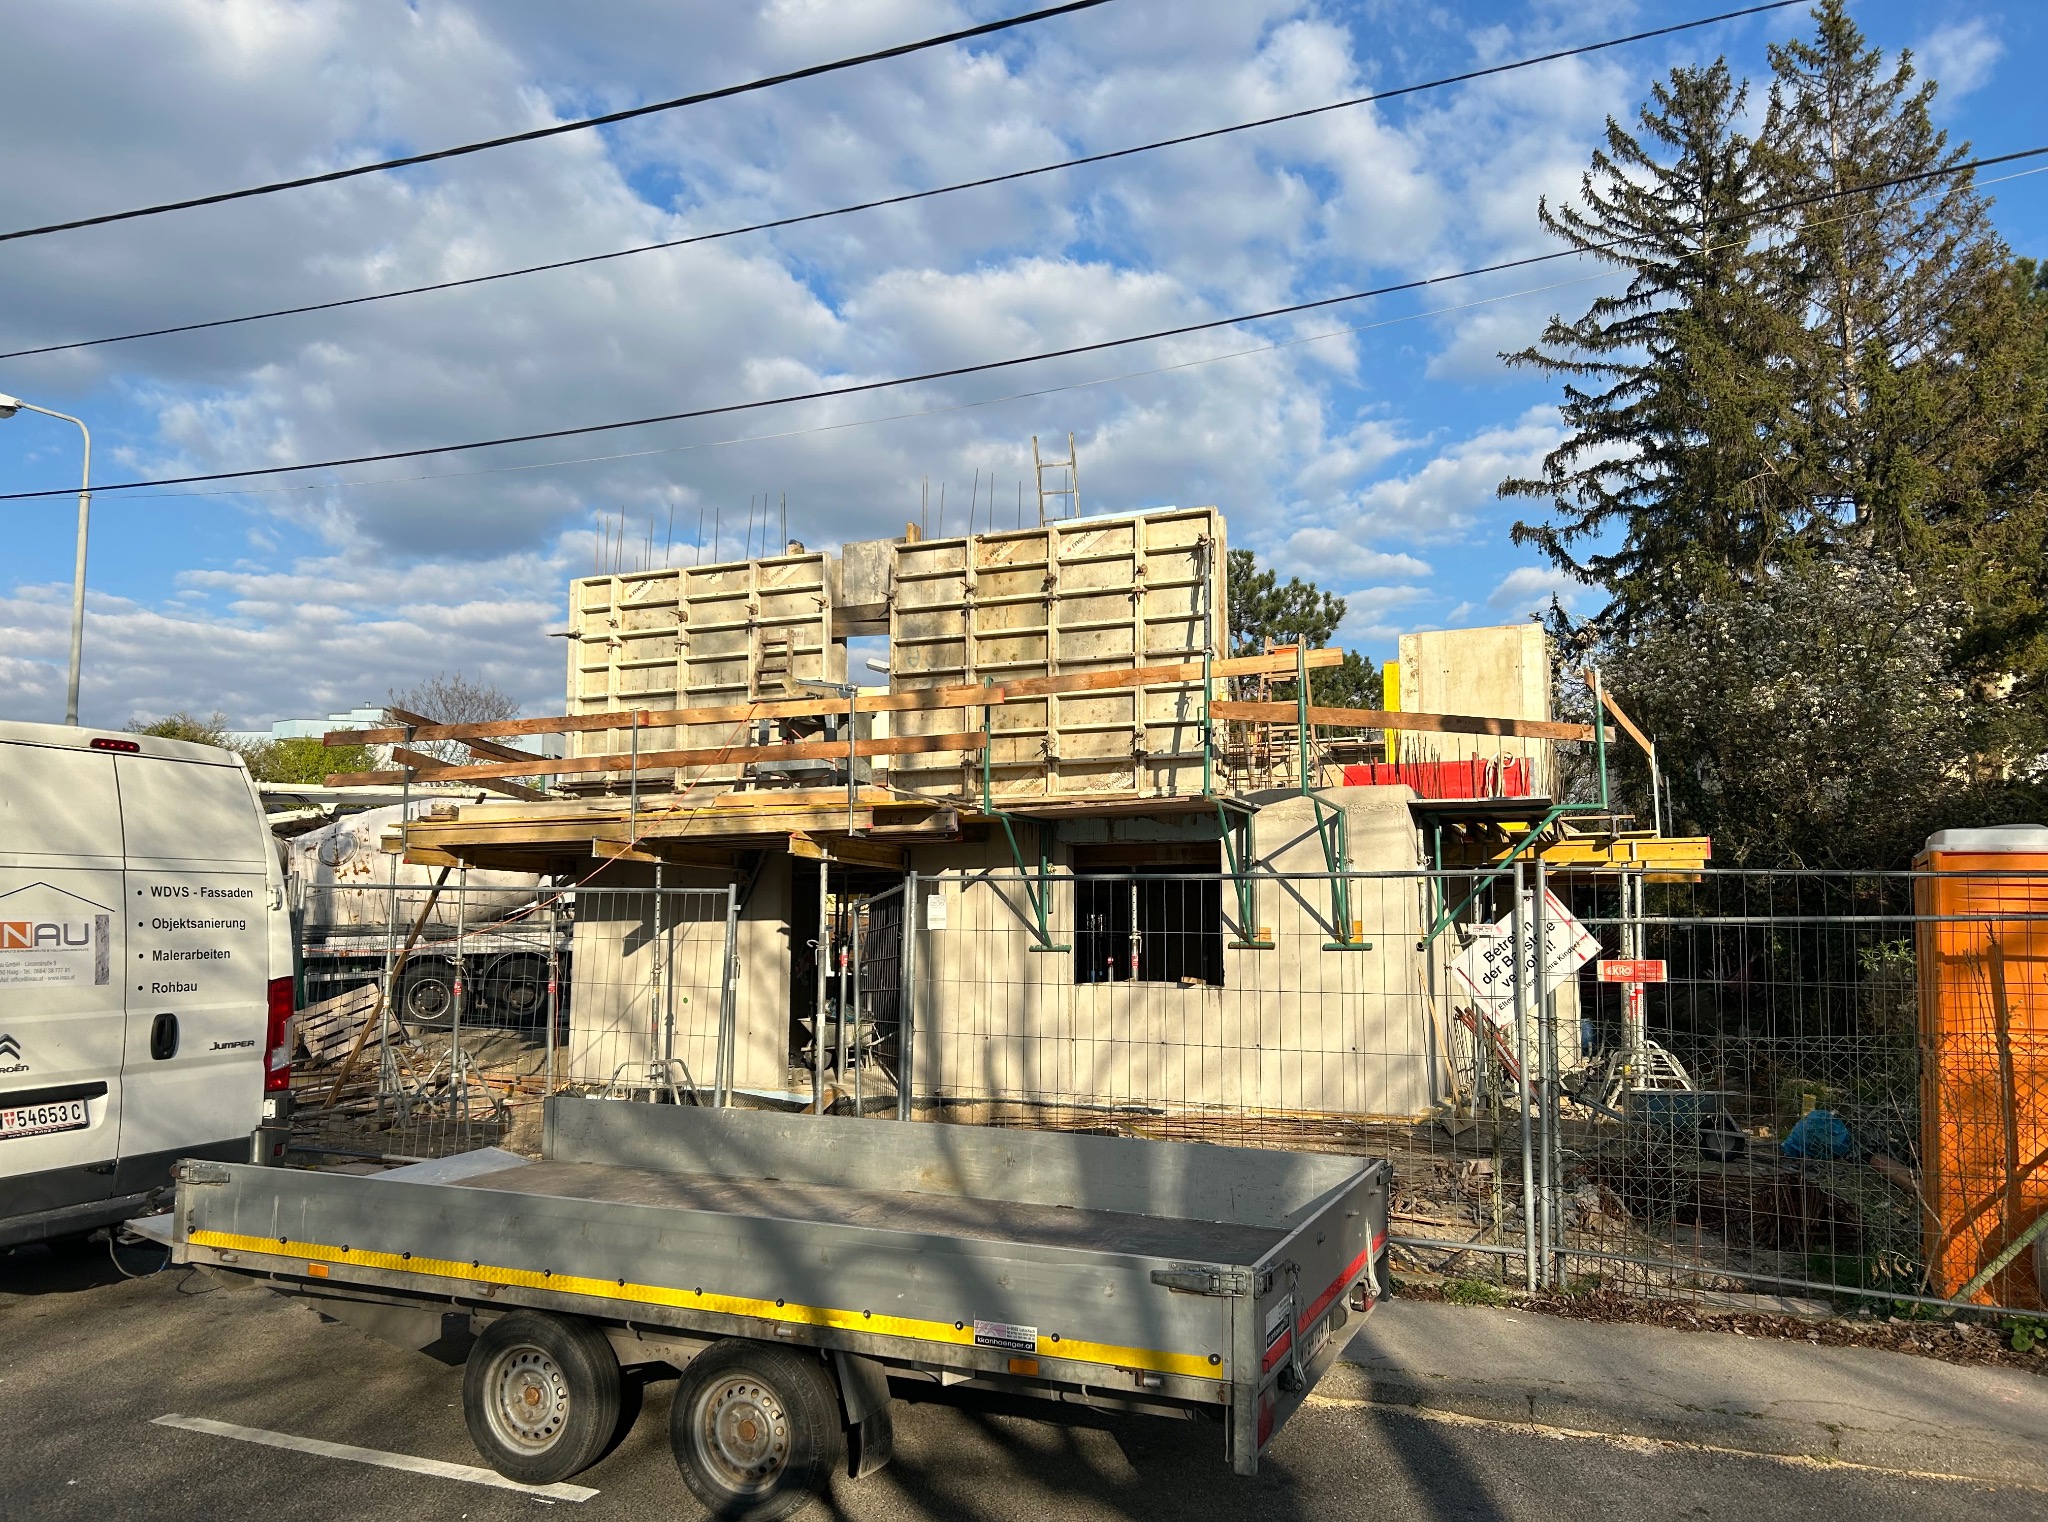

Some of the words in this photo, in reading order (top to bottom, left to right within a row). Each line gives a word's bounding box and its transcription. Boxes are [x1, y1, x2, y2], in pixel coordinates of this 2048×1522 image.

[150, 886, 190, 898] WDVS
[200, 887, 254, 898] Fassaden
[152, 918, 246, 931] Objektsanierung
[152, 949, 231, 961] Malerarbeiten
[1482, 965, 1503, 985] der
[151, 982, 198, 993] Rohbau
